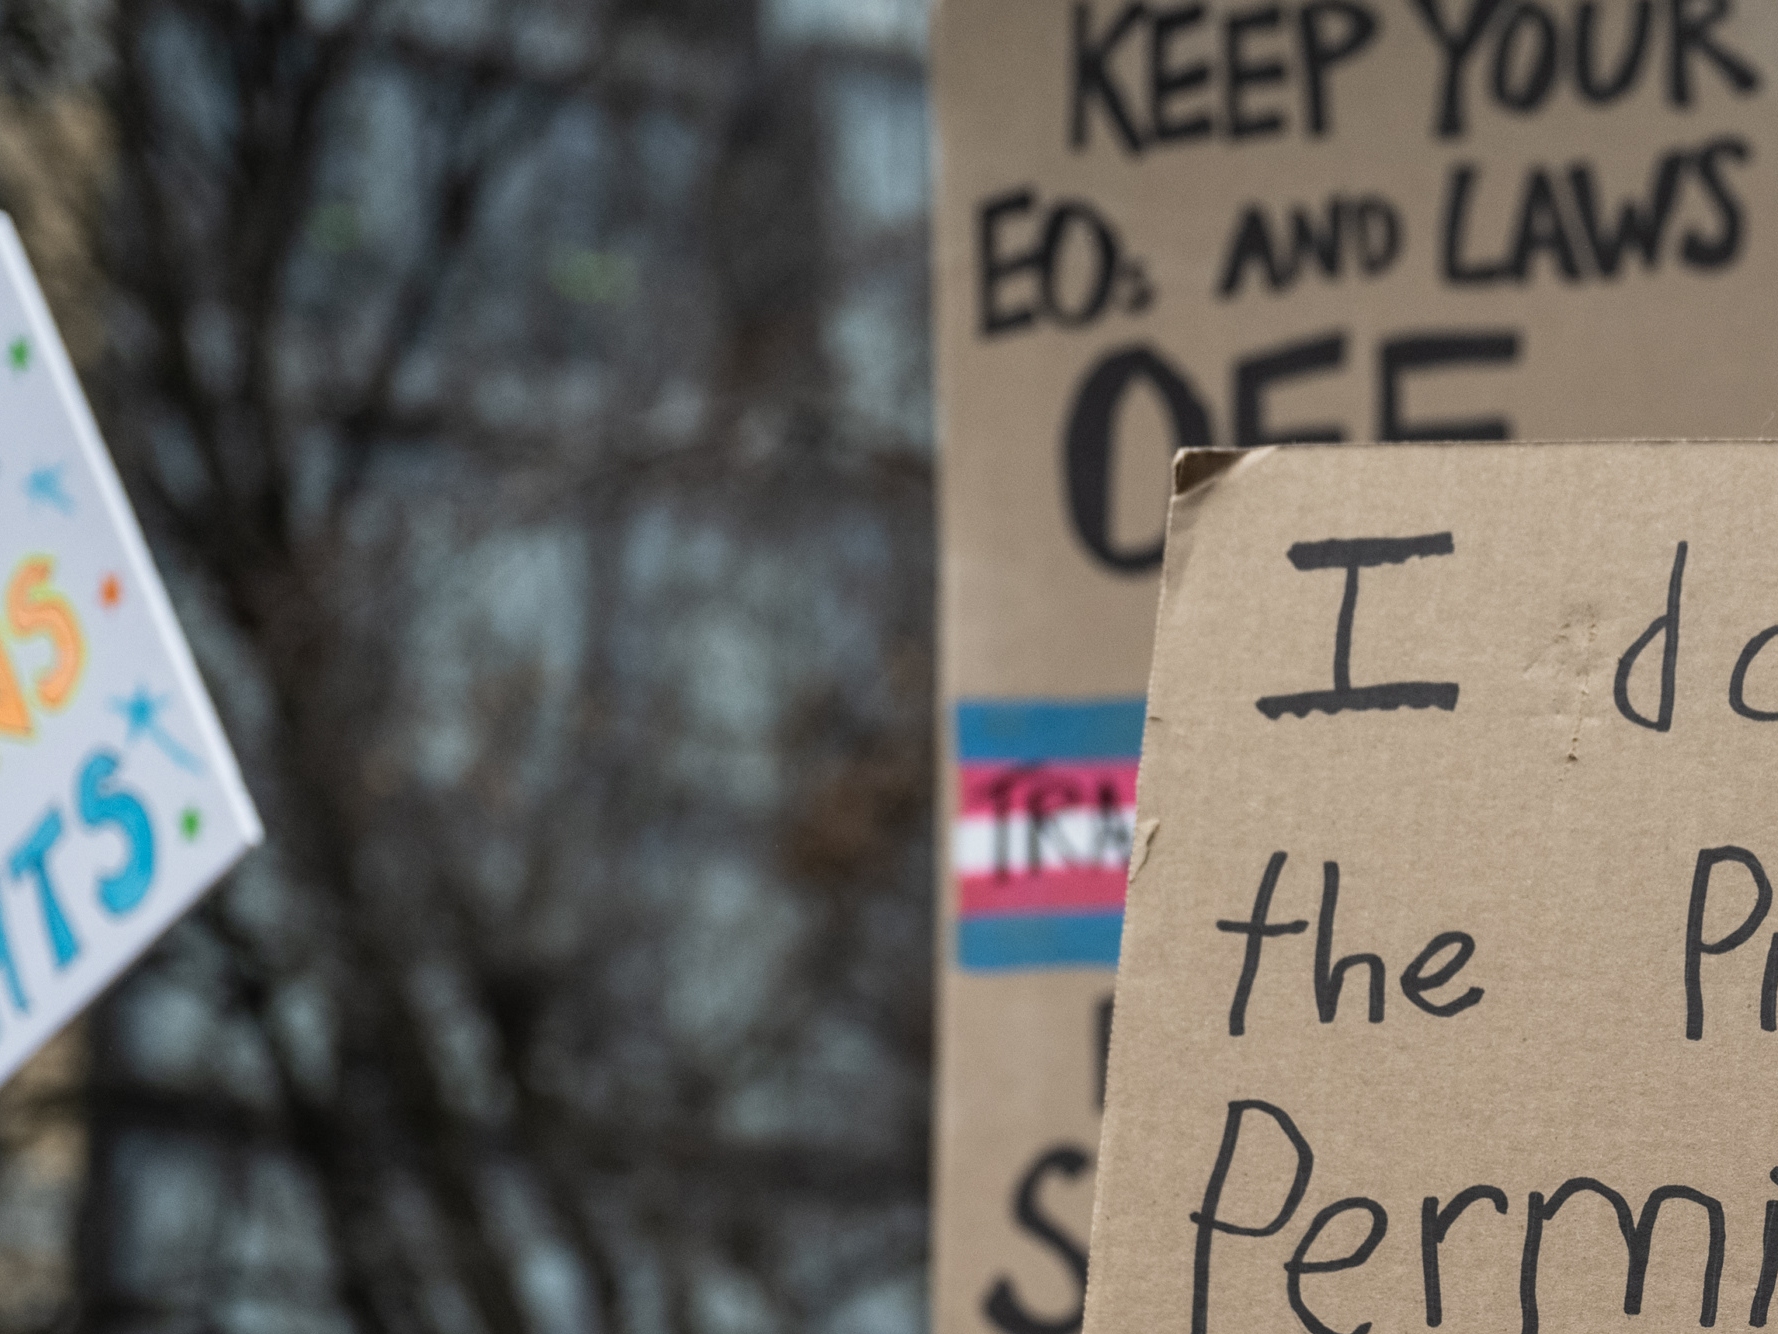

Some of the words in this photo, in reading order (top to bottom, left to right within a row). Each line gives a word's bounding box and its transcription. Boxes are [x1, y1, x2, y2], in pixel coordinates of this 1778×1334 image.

[1069, 0, 1379, 156] KEEP
[1418, 0, 1762, 139] YOUR
[1216, 194, 1402, 302] AND
[1438, 135, 1751, 286] LAWS
[1257, 534, 1458, 719] I
[1217, 852, 1484, 1035] the
